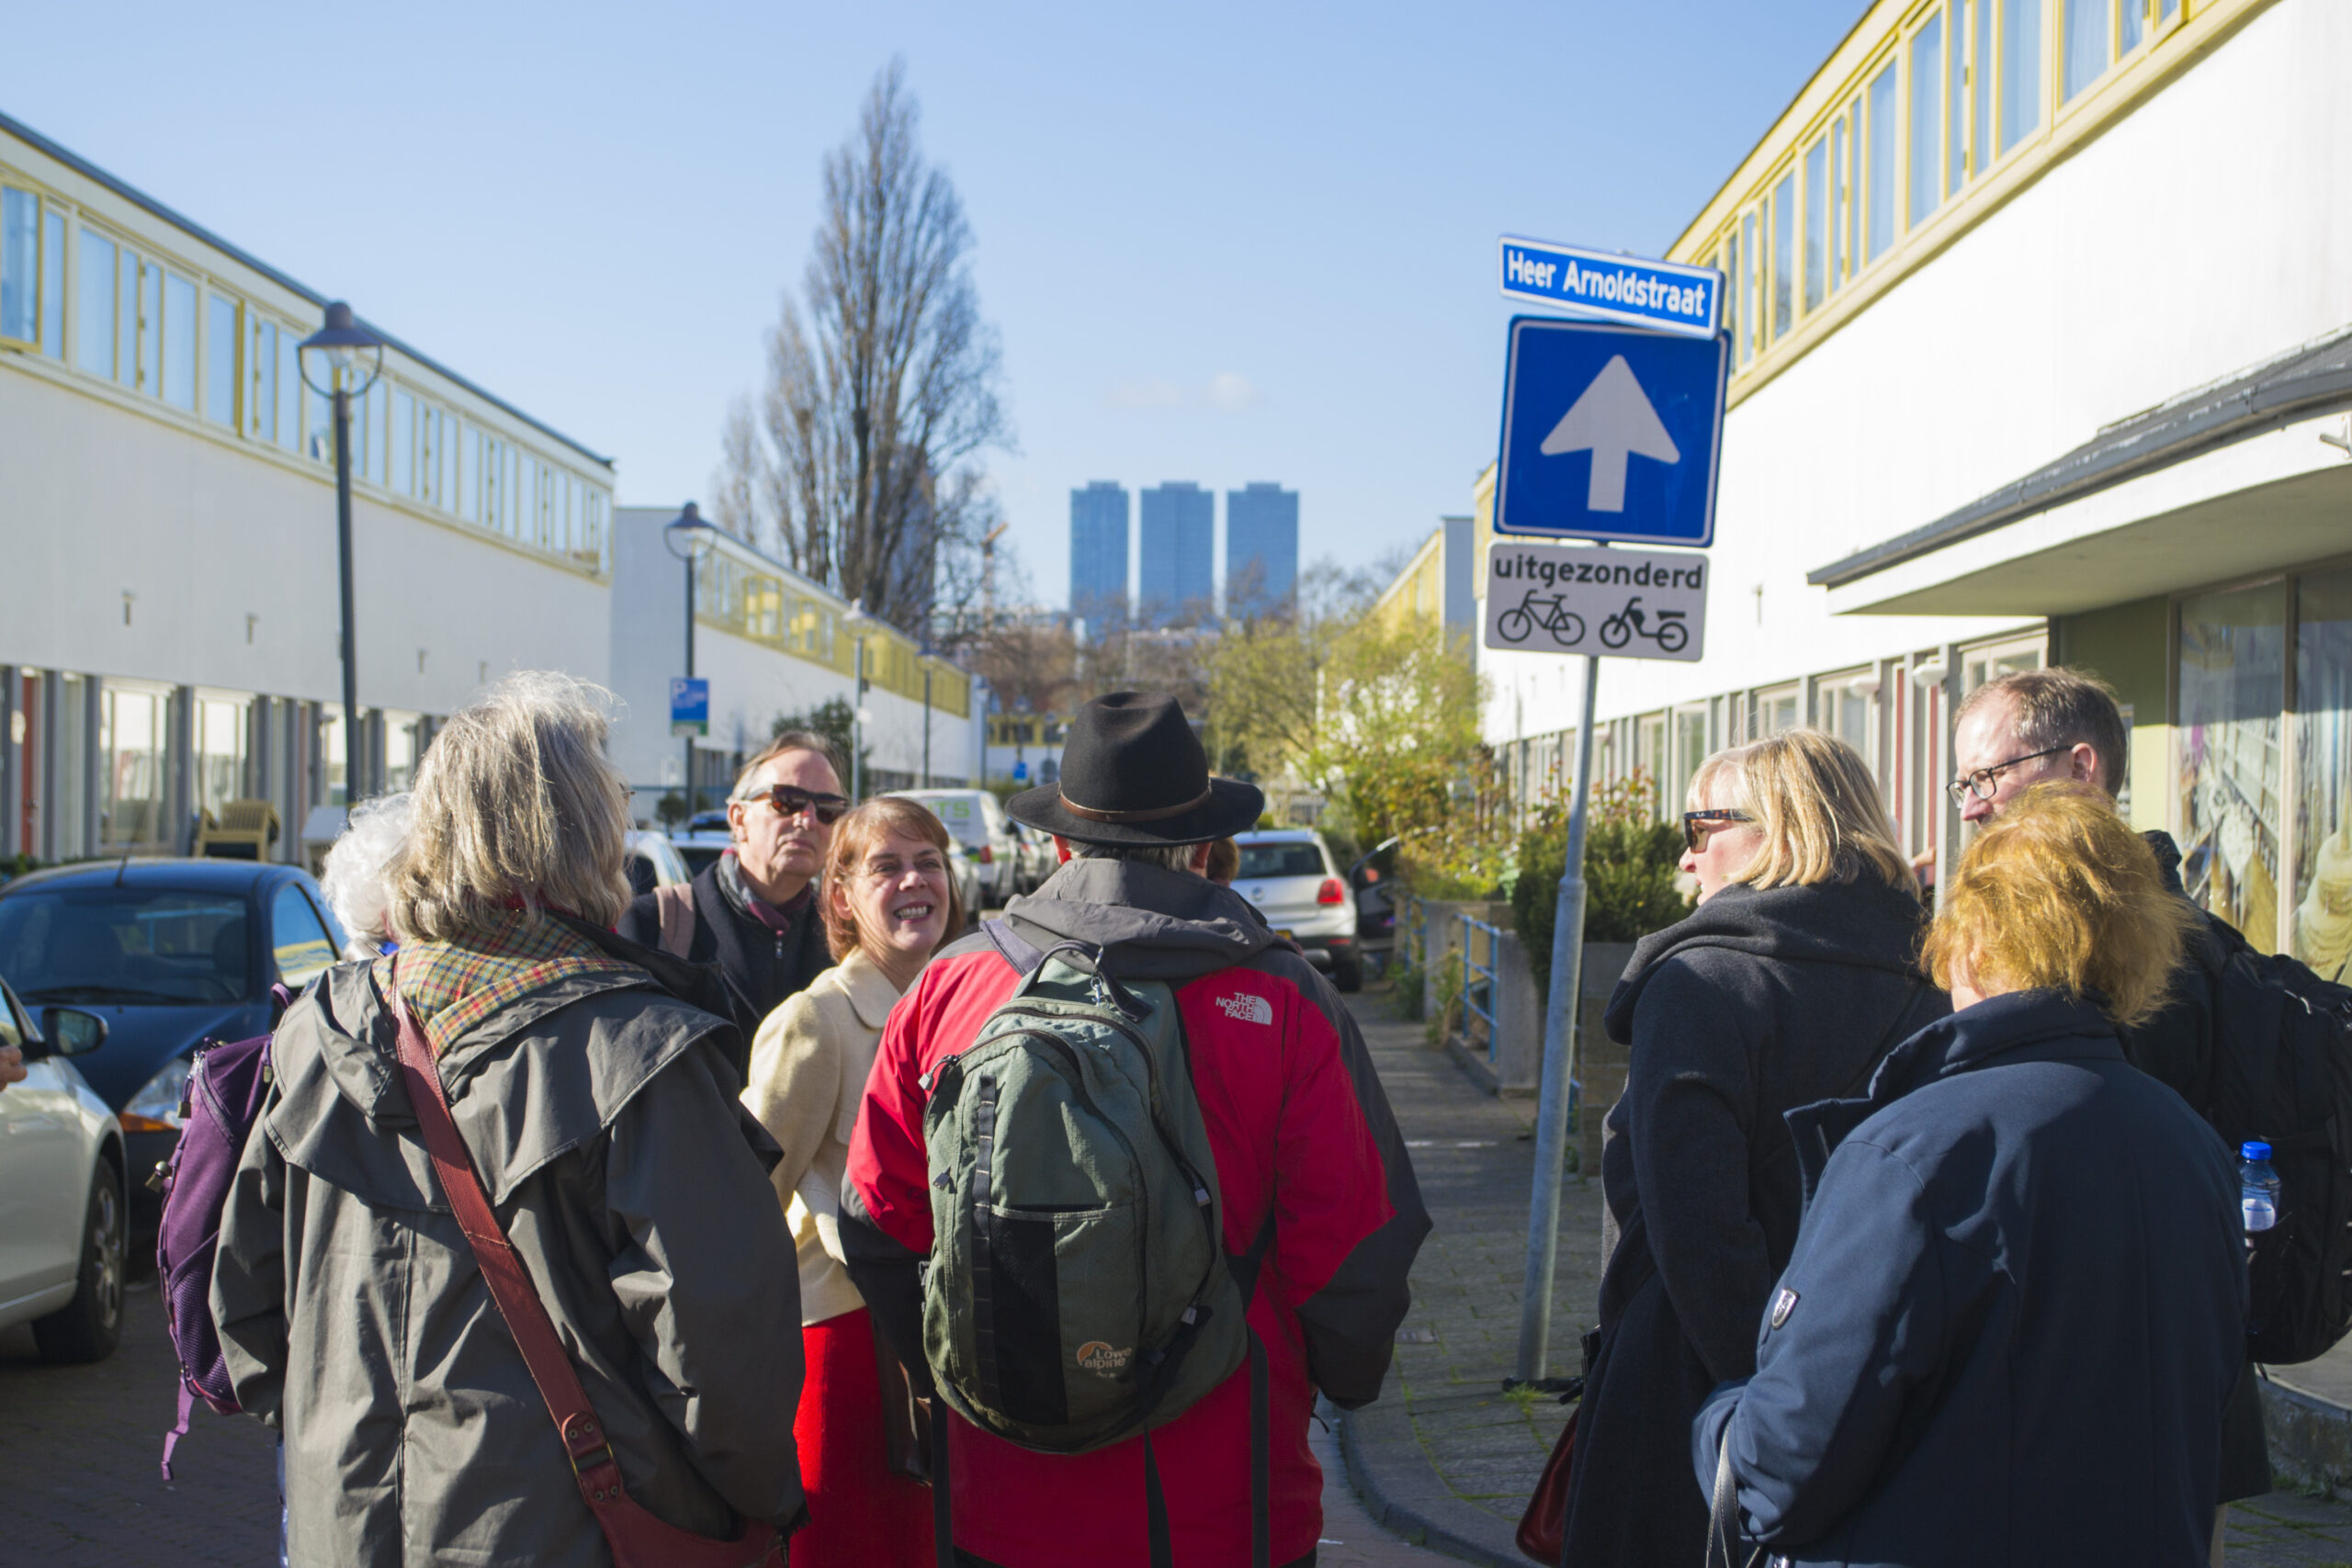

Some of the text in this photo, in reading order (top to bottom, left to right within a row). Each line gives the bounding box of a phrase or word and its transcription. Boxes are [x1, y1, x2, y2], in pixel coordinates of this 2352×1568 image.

[1508, 249, 1706, 318] Heer Arnoldstraat
[1494, 554, 1703, 590] uitgezonderd
[1234, 992, 1257, 1004] THE
[1216, 996, 1256, 1014] NORTH
[1225, 1008, 1253, 1021] FACE
[1095, 1347, 1133, 1359] Lowe
[1084, 1358, 1126, 1370] alpine
